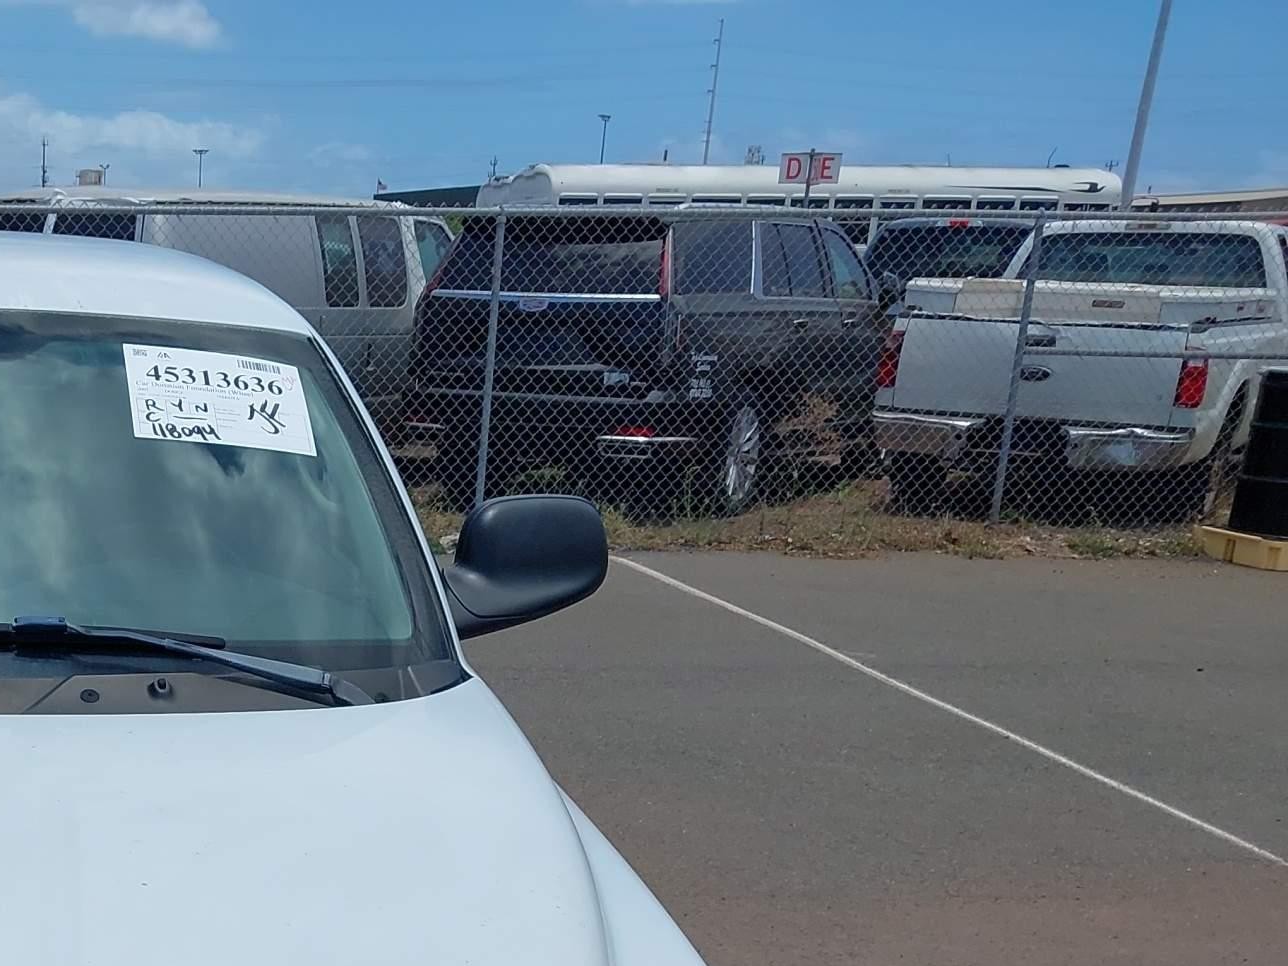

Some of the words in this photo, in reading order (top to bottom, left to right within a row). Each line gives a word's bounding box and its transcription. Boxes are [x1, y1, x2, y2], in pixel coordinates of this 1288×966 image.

[785, 157, 802, 180] D
[820, 157, 835, 180] E
[146, 364, 284, 396] 45313636
[144, 399, 165, 411] R
[194, 402, 209, 413] N
